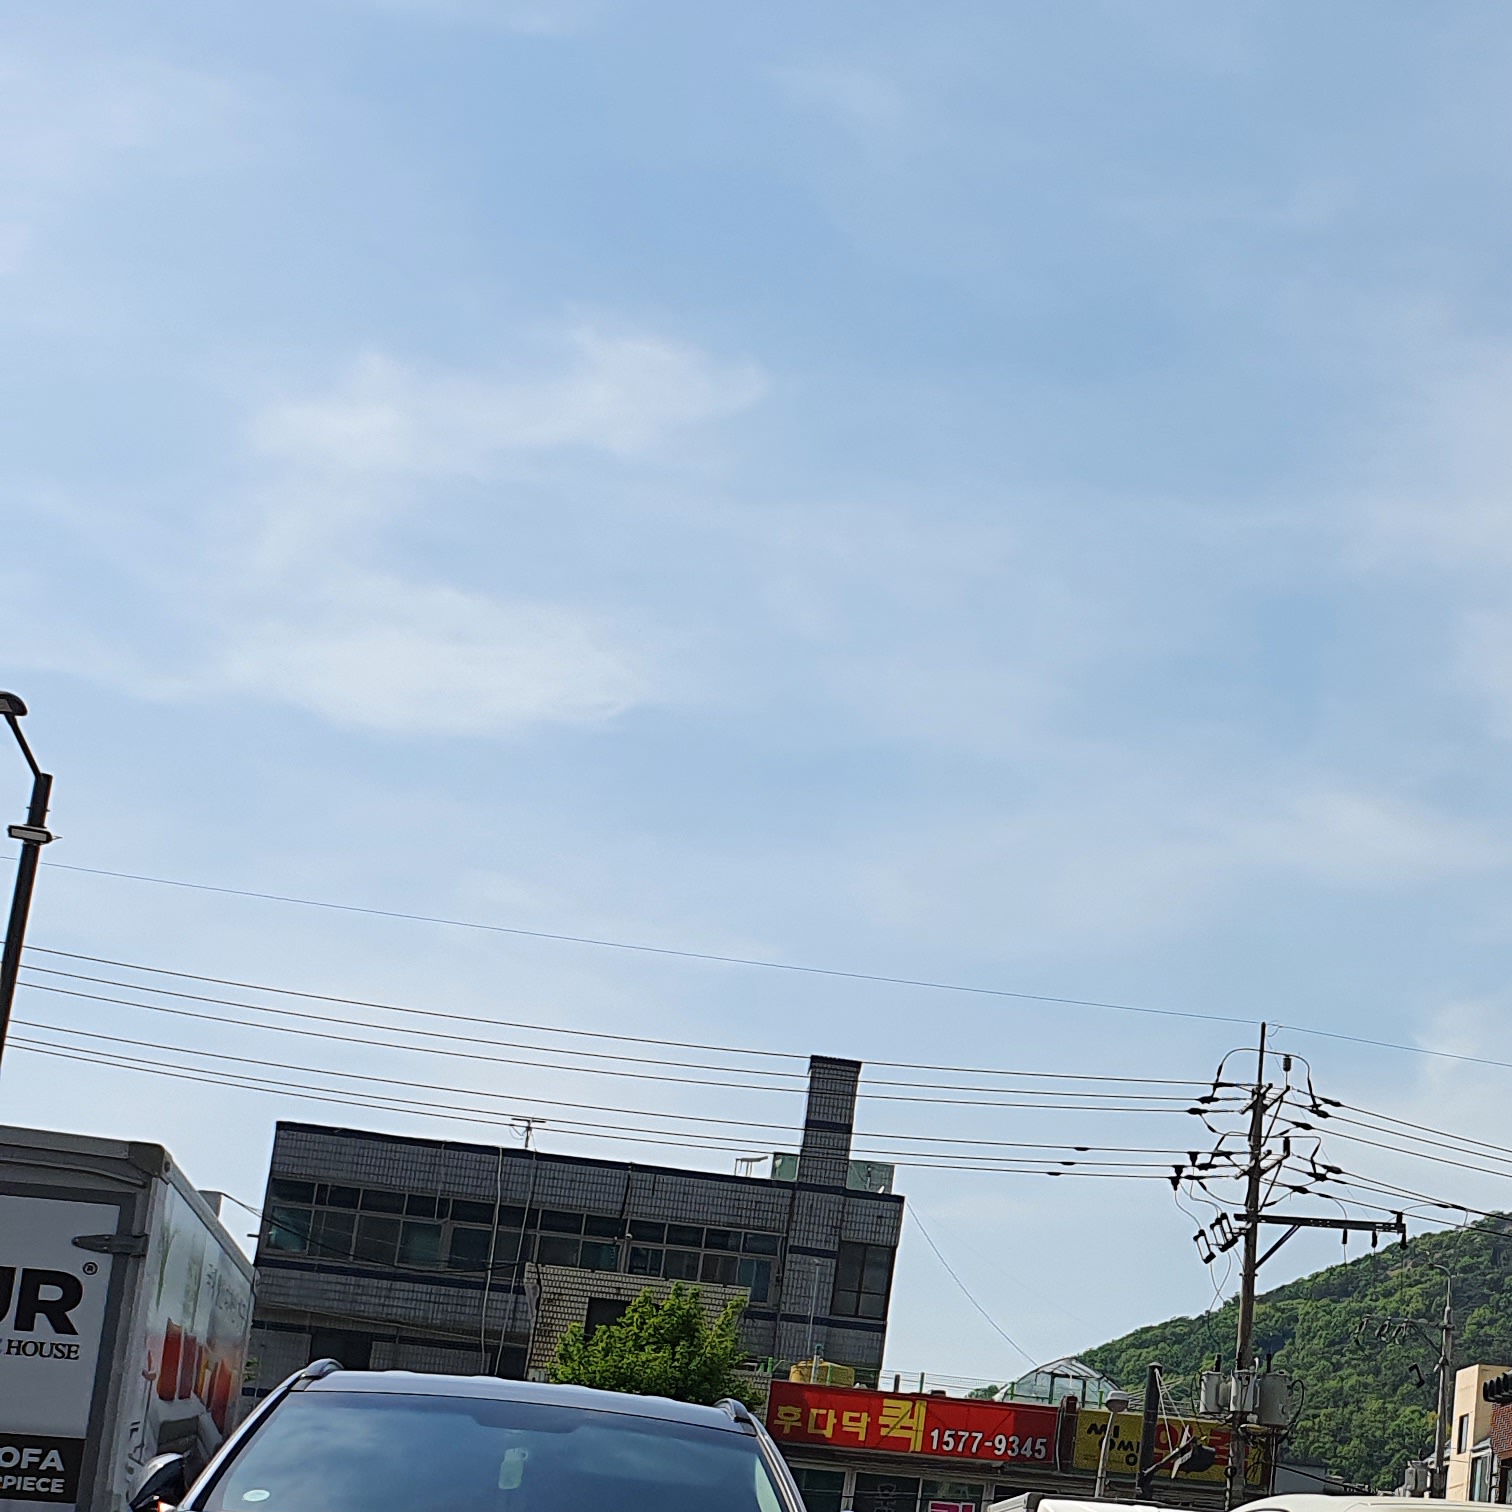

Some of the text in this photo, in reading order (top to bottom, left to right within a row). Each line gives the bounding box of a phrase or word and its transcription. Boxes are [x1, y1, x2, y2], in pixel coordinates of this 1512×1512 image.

[5, 1338, 80, 1360] HOUSE
[930, 1427, 1047, 1459] 1577-9345
[0, 1475, 65, 1493] PIECE
